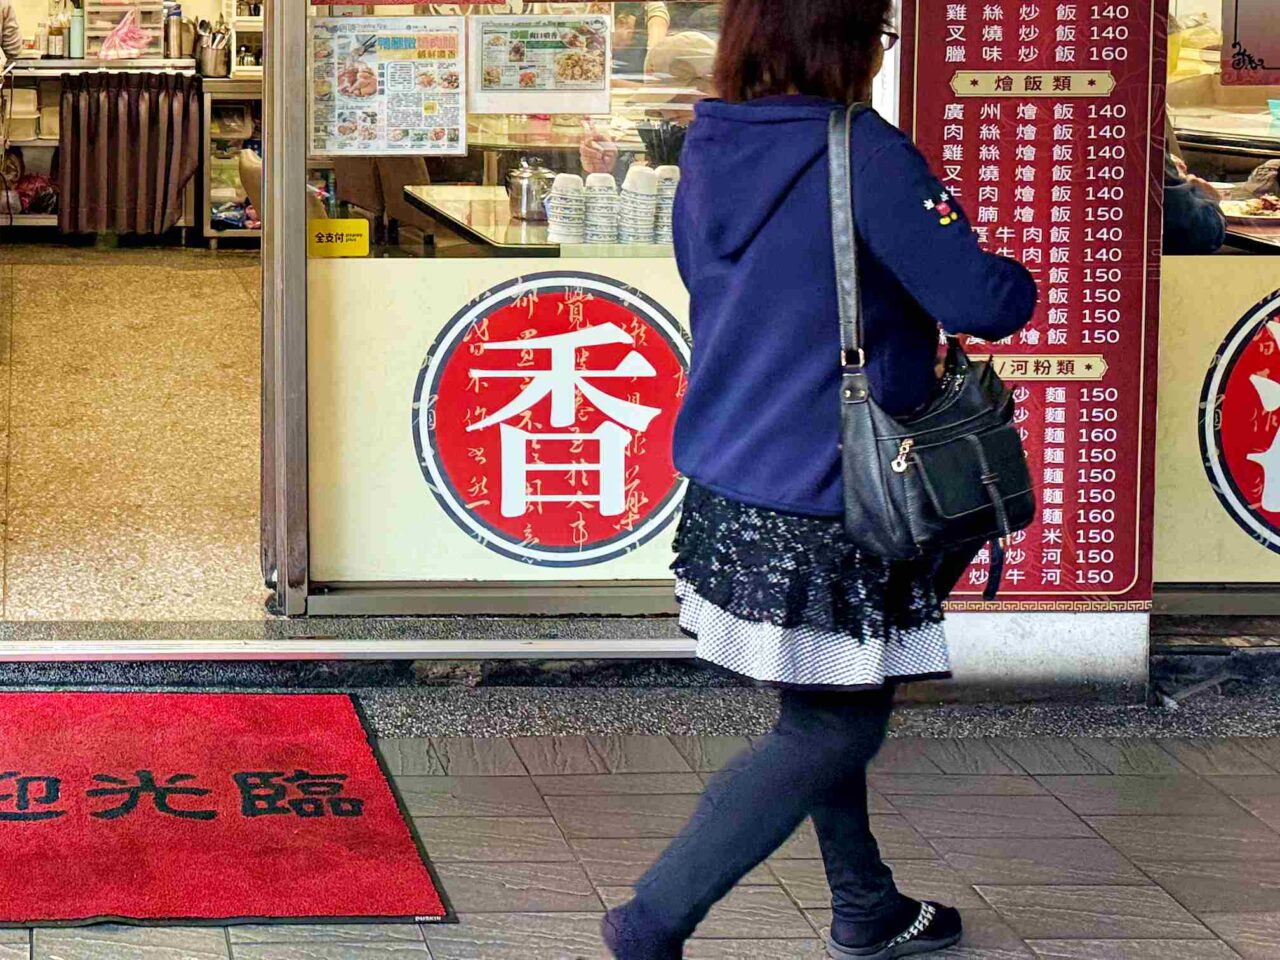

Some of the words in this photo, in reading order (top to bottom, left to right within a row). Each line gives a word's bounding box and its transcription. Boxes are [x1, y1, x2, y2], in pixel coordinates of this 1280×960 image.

[947, 4, 1076, 20] 雞絲炒飯
[1091, 6, 1128, 18] 140
[946, 25, 1075, 41] 叉燒炒飯
[1091, 27, 1128, 39] 140
[1090, 47, 1127, 60] 160
[944, 104, 1073, 119] 廣州燴飯
[1089, 105, 1126, 117] 140
[944, 124, 1072, 140] 肉絲燴飯
[1088, 125, 1125, 138] 140
[943, 145, 1072, 160] 雞絲燴飯
[1088, 146, 1124, 159] 140
[943, 165, 1072, 181] 叉燒燴飯
[1087, 167, 1124, 179] 140
[465, 321, 662, 518] 香
